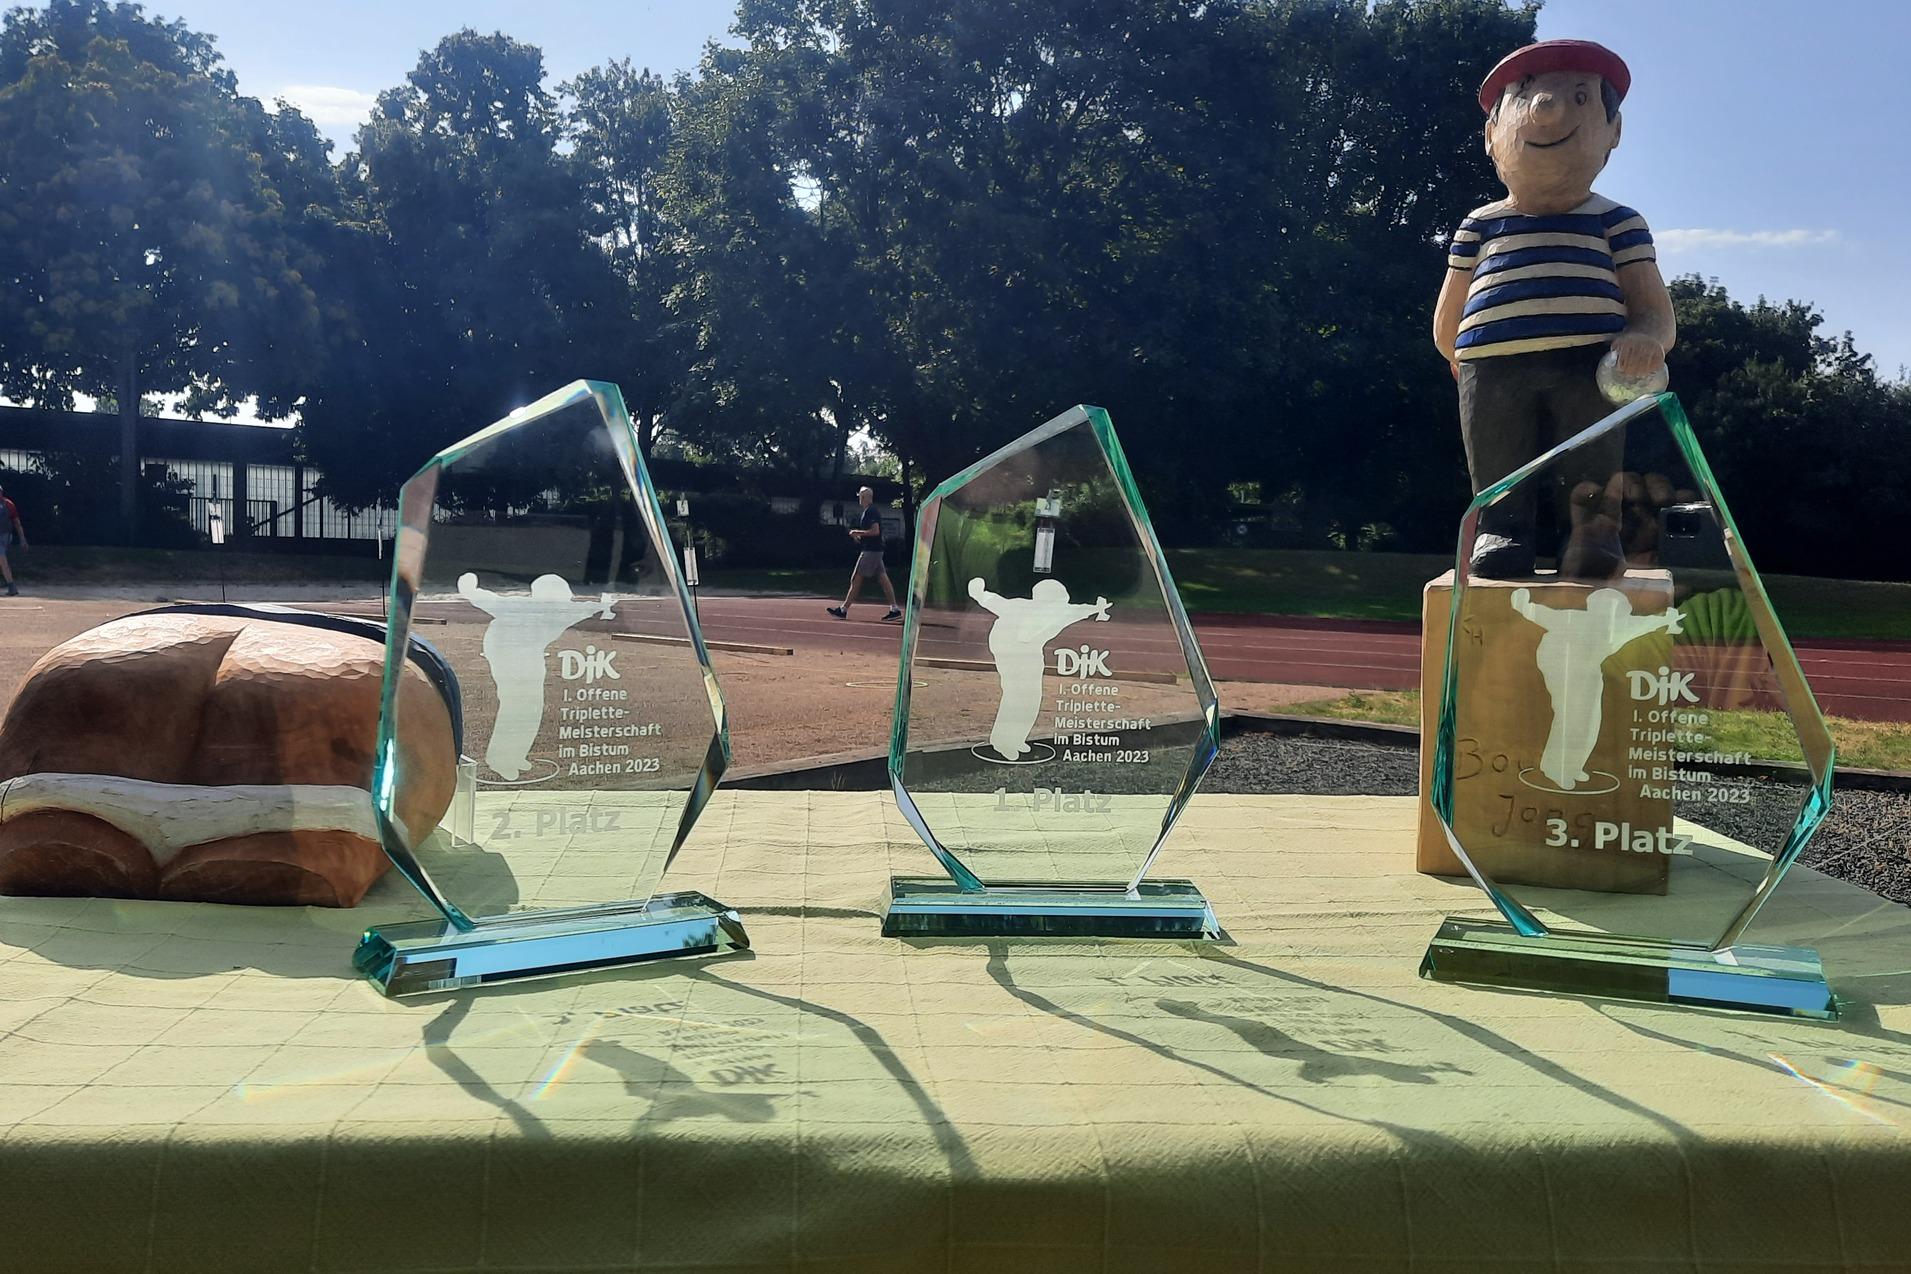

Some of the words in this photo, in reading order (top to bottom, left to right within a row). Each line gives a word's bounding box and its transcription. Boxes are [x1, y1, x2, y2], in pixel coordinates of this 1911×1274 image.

[576, 688, 628, 701] Offene
[1071, 683, 1119, 696] Offene
[560, 706, 631, 723] Triplette-
[1056, 699, 1121, 714] Triplette-
[1054, 716, 1152, 730] Meisterschaft
[1648, 710, 1708, 725] Offene
[559, 723, 662, 739] Meisterschaft
[1073, 732, 1120, 746] Bistum
[1630, 728, 1712, 745] Triplette-
[580, 743, 629, 757] Bistum
[1062, 749, 1112, 762] Aachen
[1116, 750, 1150, 763] 2023
[1628, 746, 1752, 765] Meisterschaft
[568, 761, 621, 776] Aachen
[625, 758, 660, 773] 2023
[1652, 766, 1712, 782] Bistum
[994, 786, 1018, 813] 1.
[1033, 787, 1112, 814] Platz
[1640, 784, 1702, 801] Aachen
[1707, 787, 1751, 804] 2023
[492, 814, 522, 840] 2.
[536, 807, 621, 837] Platz
[1544, 818, 1580, 848] 3.
[1594, 822, 1694, 856] Platz
